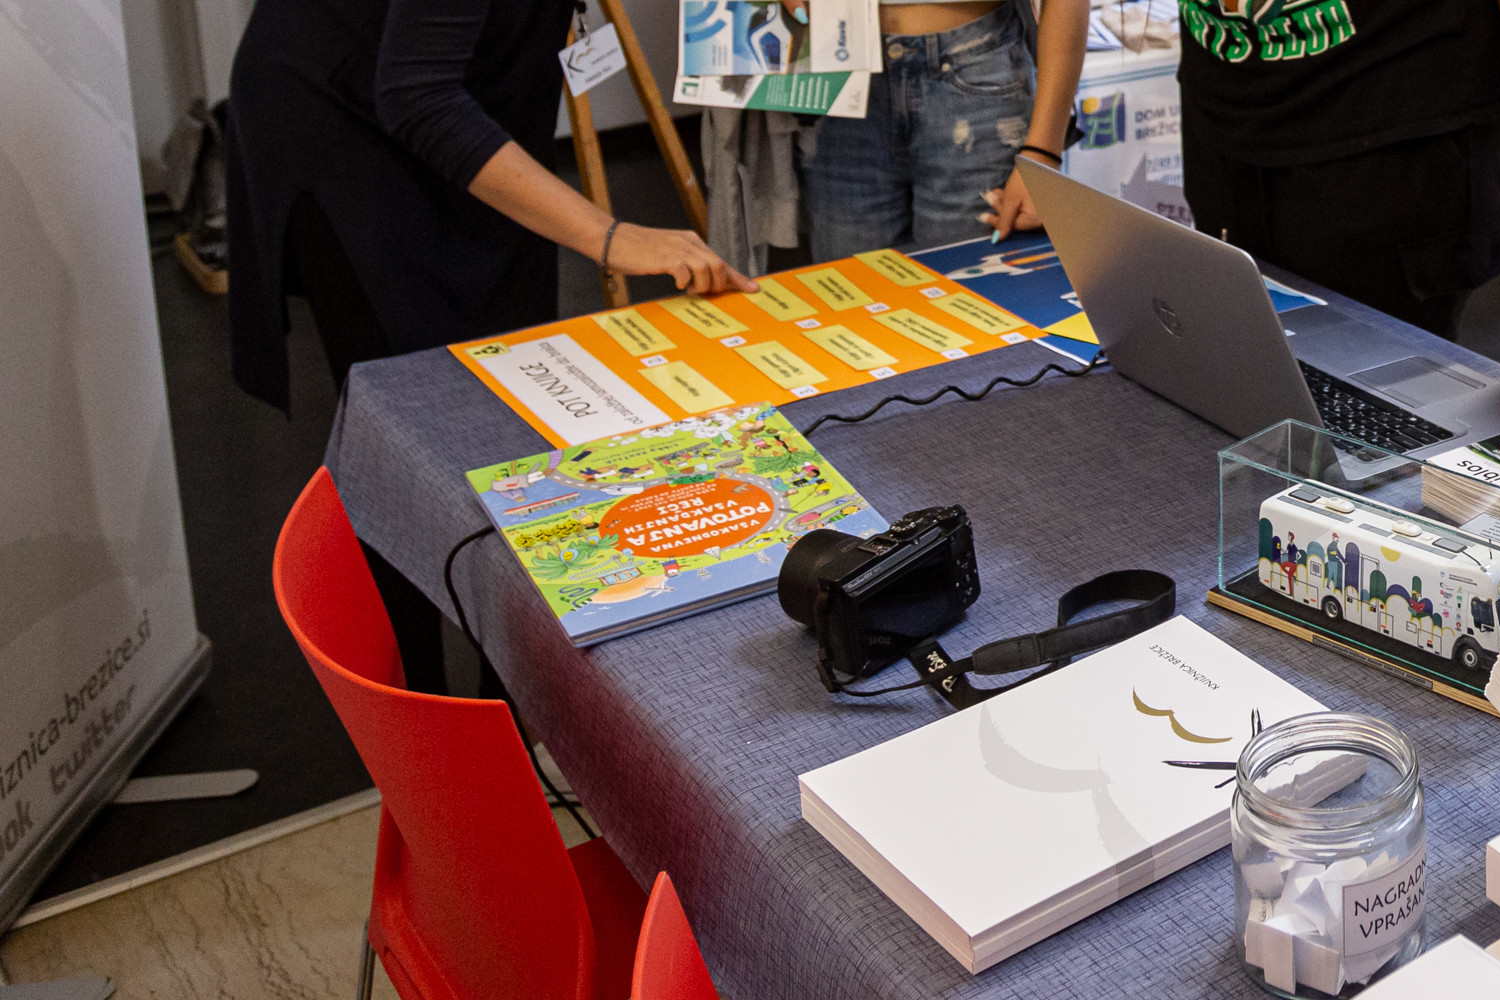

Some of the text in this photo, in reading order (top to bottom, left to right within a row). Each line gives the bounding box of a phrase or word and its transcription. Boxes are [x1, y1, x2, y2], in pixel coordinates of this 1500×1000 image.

[517, 360, 599, 418] POT KNJIGE
[622, 498, 737, 534] VSAKDANJIH
[625, 500, 771, 548] POTOVANJA
[654, 496, 705, 518] REČI
[649, 518, 760, 553] VSAKODNEVNA
[1148, 644, 1220, 690] KNJIŽNICA BREŽICE
[46, 683, 138, 796] twitter
